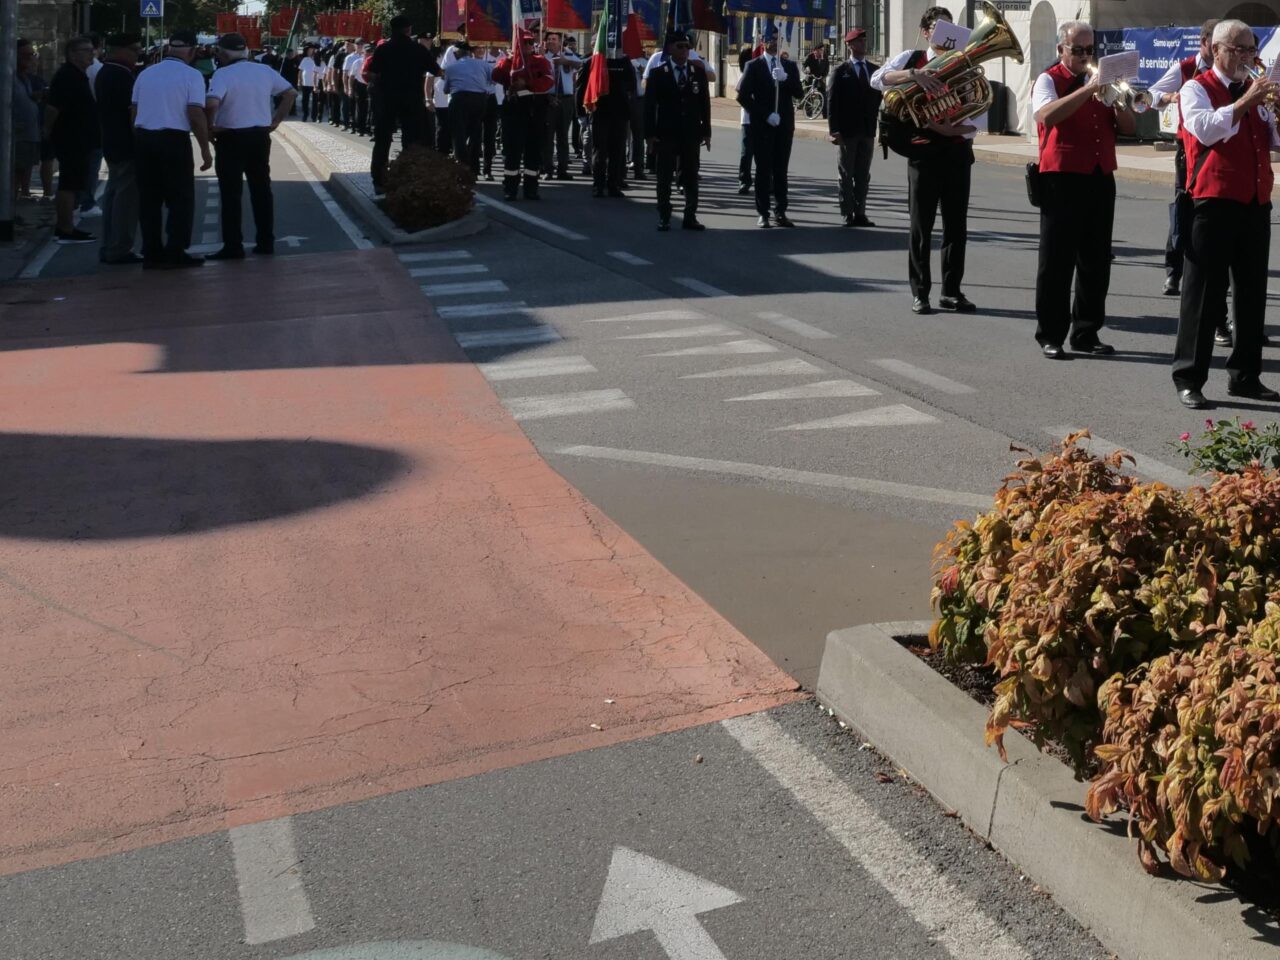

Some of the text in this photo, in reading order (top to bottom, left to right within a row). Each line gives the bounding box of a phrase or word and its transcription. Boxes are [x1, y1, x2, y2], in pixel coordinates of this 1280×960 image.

[1153, 38, 1166, 47] Siamo
[1139, 57, 1145, 68] al
[1145, 57, 1168, 68] servizio
